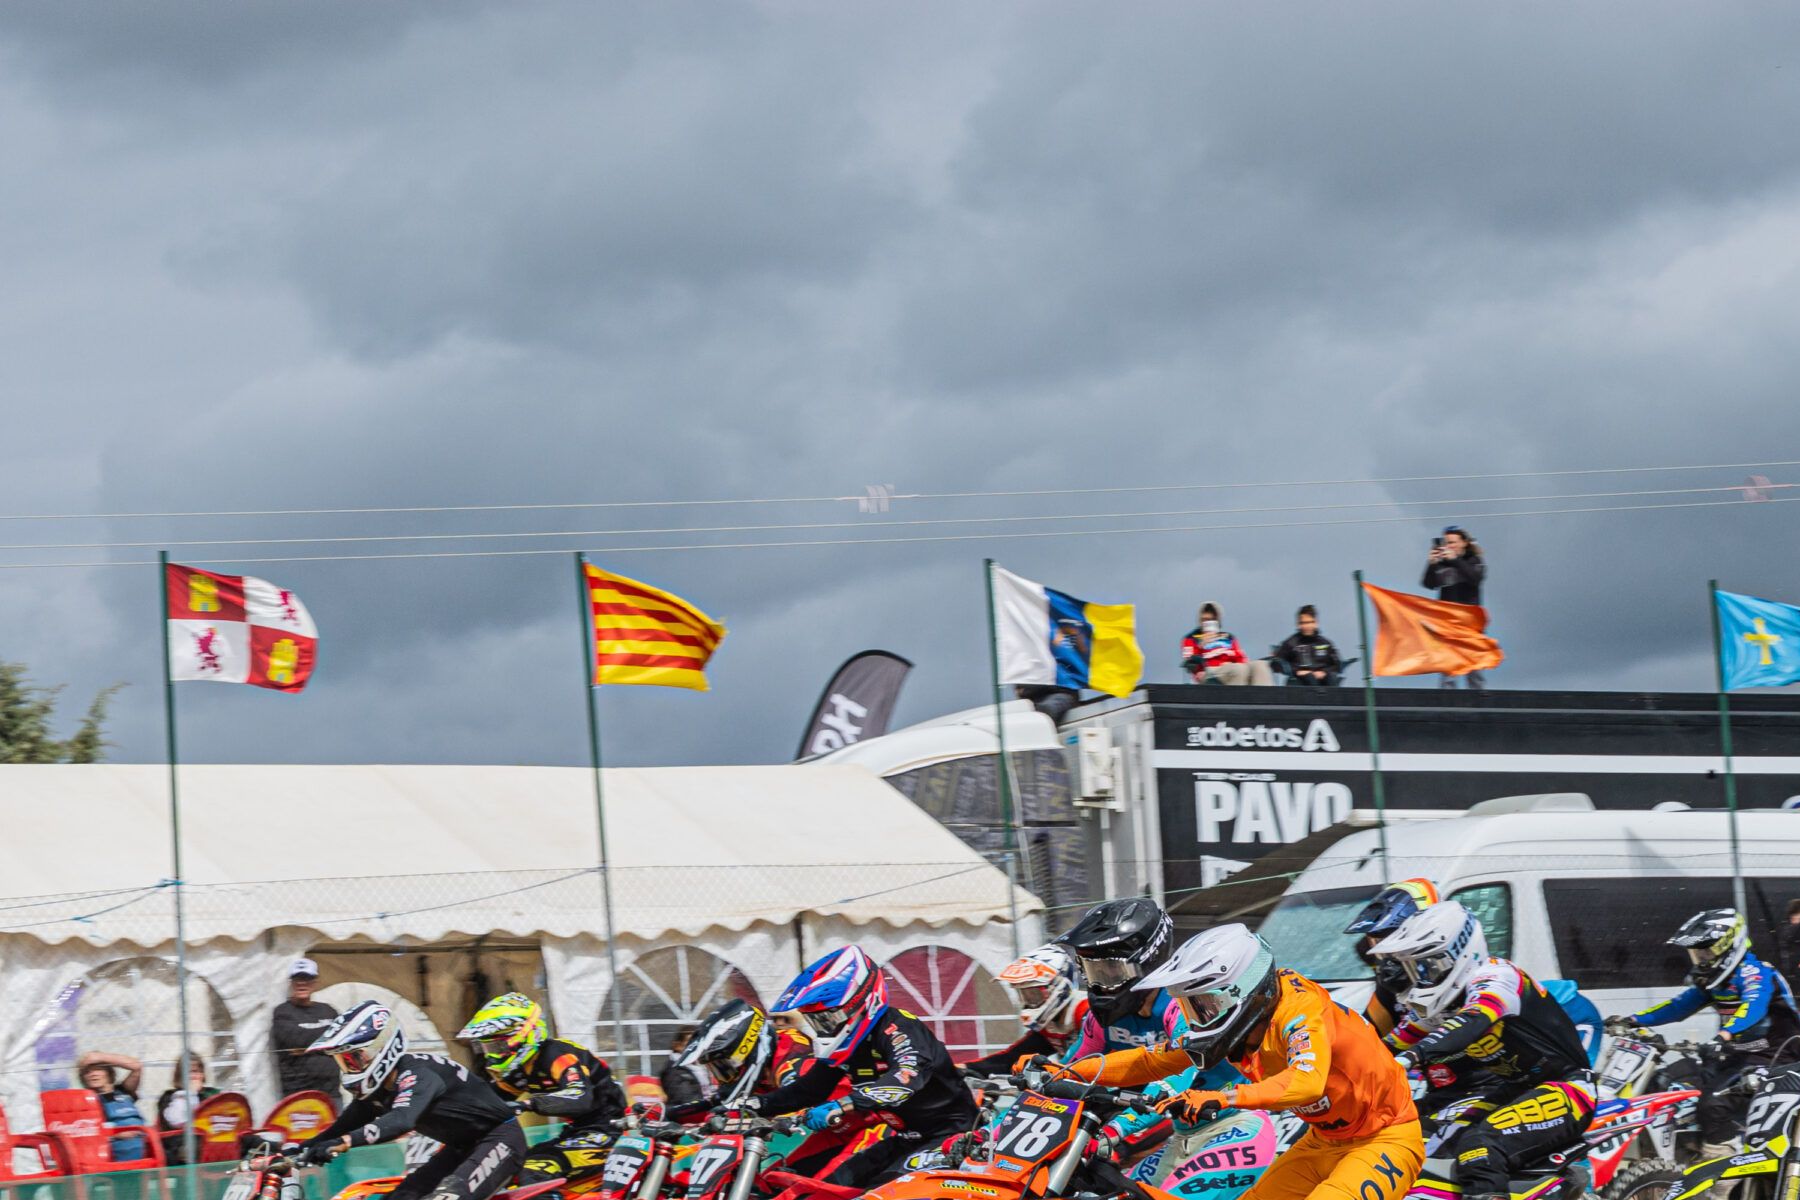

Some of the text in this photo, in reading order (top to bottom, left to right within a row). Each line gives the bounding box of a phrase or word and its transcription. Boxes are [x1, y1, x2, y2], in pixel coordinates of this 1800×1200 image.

[1194, 780, 1353, 844] PAVO
[1108, 1026, 1173, 1047] Beta
[1486, 1092, 1568, 1130] SB2
[1525, 1117, 1567, 1132] TALENTS
[995, 1111, 1063, 1158] 78
[1501, 1128, 1521, 1136] MX
[691, 1149, 734, 1185] 97
[1174, 1144, 1258, 1179] MOTS
[1179, 1172, 1256, 1195] Beta
